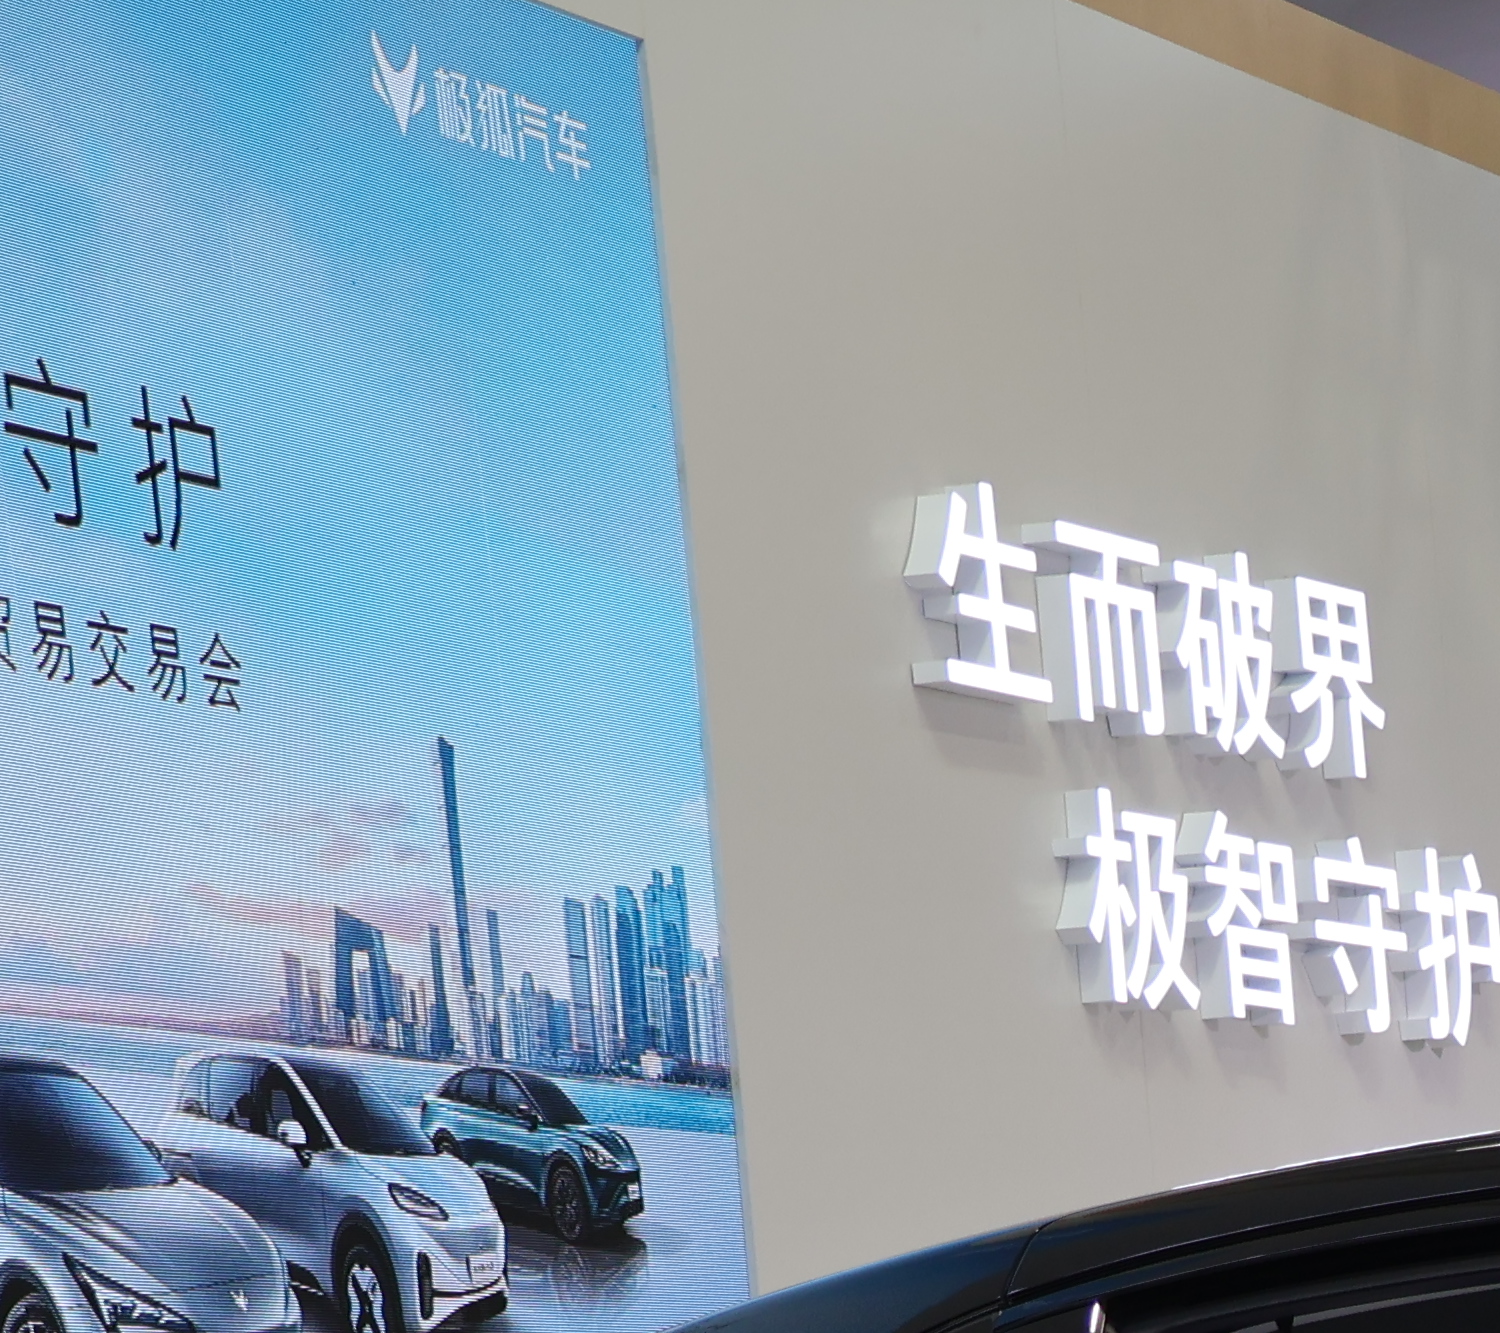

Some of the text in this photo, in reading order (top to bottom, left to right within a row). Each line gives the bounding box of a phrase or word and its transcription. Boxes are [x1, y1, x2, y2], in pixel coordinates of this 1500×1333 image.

[432, 66, 592, 181] 极狐汽车
[936, 480, 1386, 780] 生而破界
